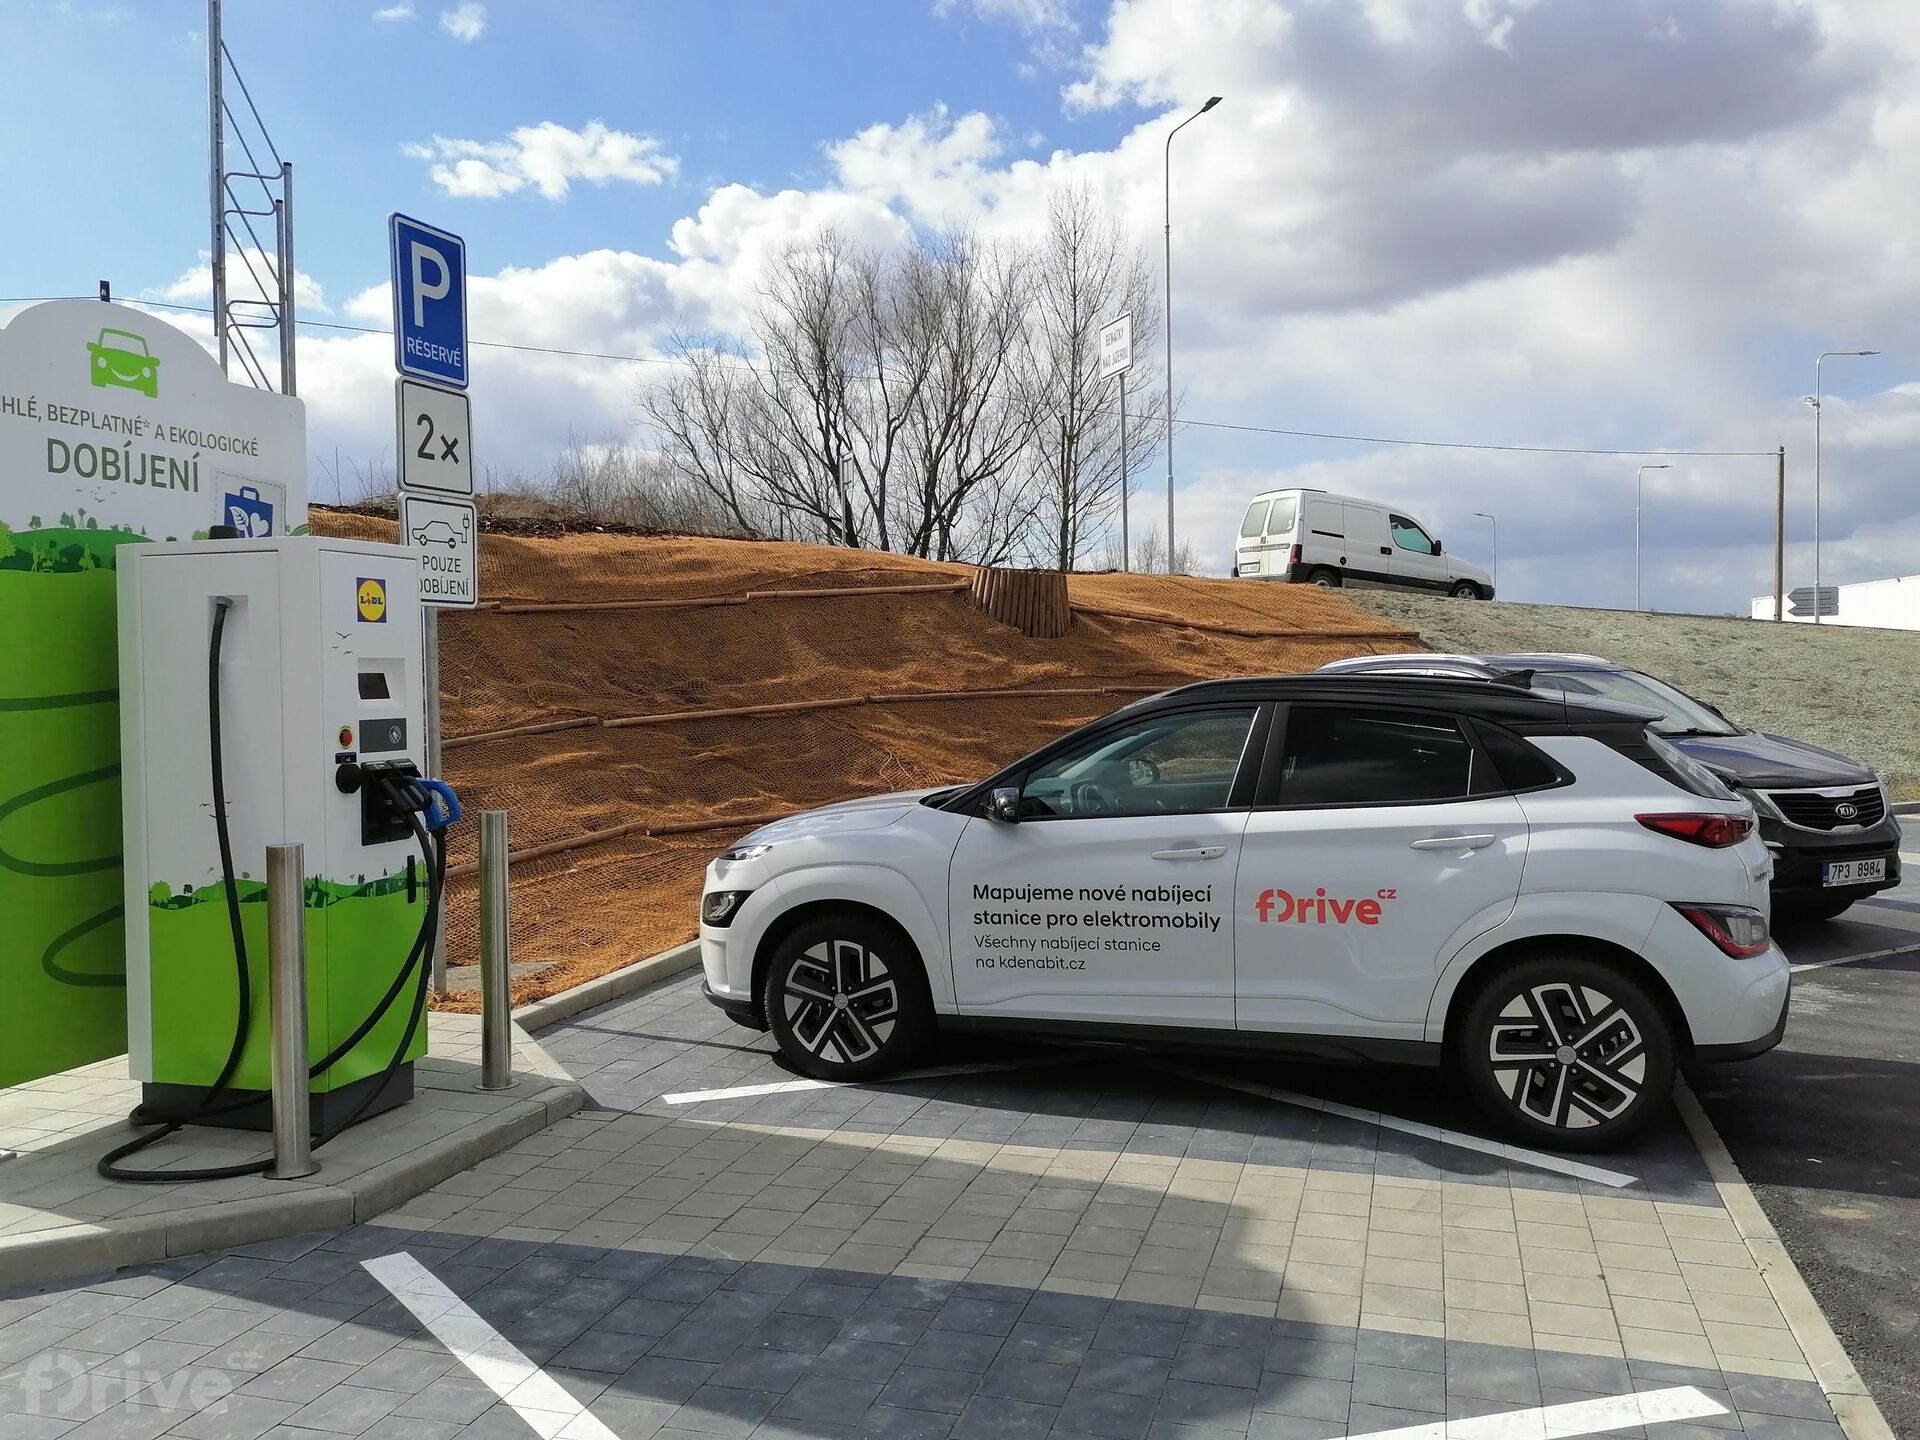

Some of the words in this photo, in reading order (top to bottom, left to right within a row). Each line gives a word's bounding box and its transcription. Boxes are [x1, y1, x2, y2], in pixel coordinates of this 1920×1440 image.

[411, 240, 450, 328] P
[406, 336, 462, 367] RÉSERVÉ
[154, 424, 165, 440] A
[169, 426, 259, 457] EKOLOGICKÉ
[47, 437, 200, 493] DOBÍJENÍ
[422, 555, 461, 574] POUZE
[1839, 806, 1855, 816] KIA
[1832, 864, 1850, 880] 7P3
[1857, 860, 1880, 877] 8984
[973, 884, 1074, 903] Mapujeme
[1079, 885, 1127, 901] nové
[1131, 885, 1212, 905] nabíjecí
[973, 909, 1042, 926] stanice
[1047, 914, 1078, 929] pro
[1083, 911, 1221, 933] elektromobily
[974, 935, 1037, 951] Všechny
[1041, 936, 1100, 952] nabíjecí
[1104, 937, 1161, 952] stanice
[975, 957, 995, 968] na
[1000, 955, 1086, 970] kdenabit.cz
